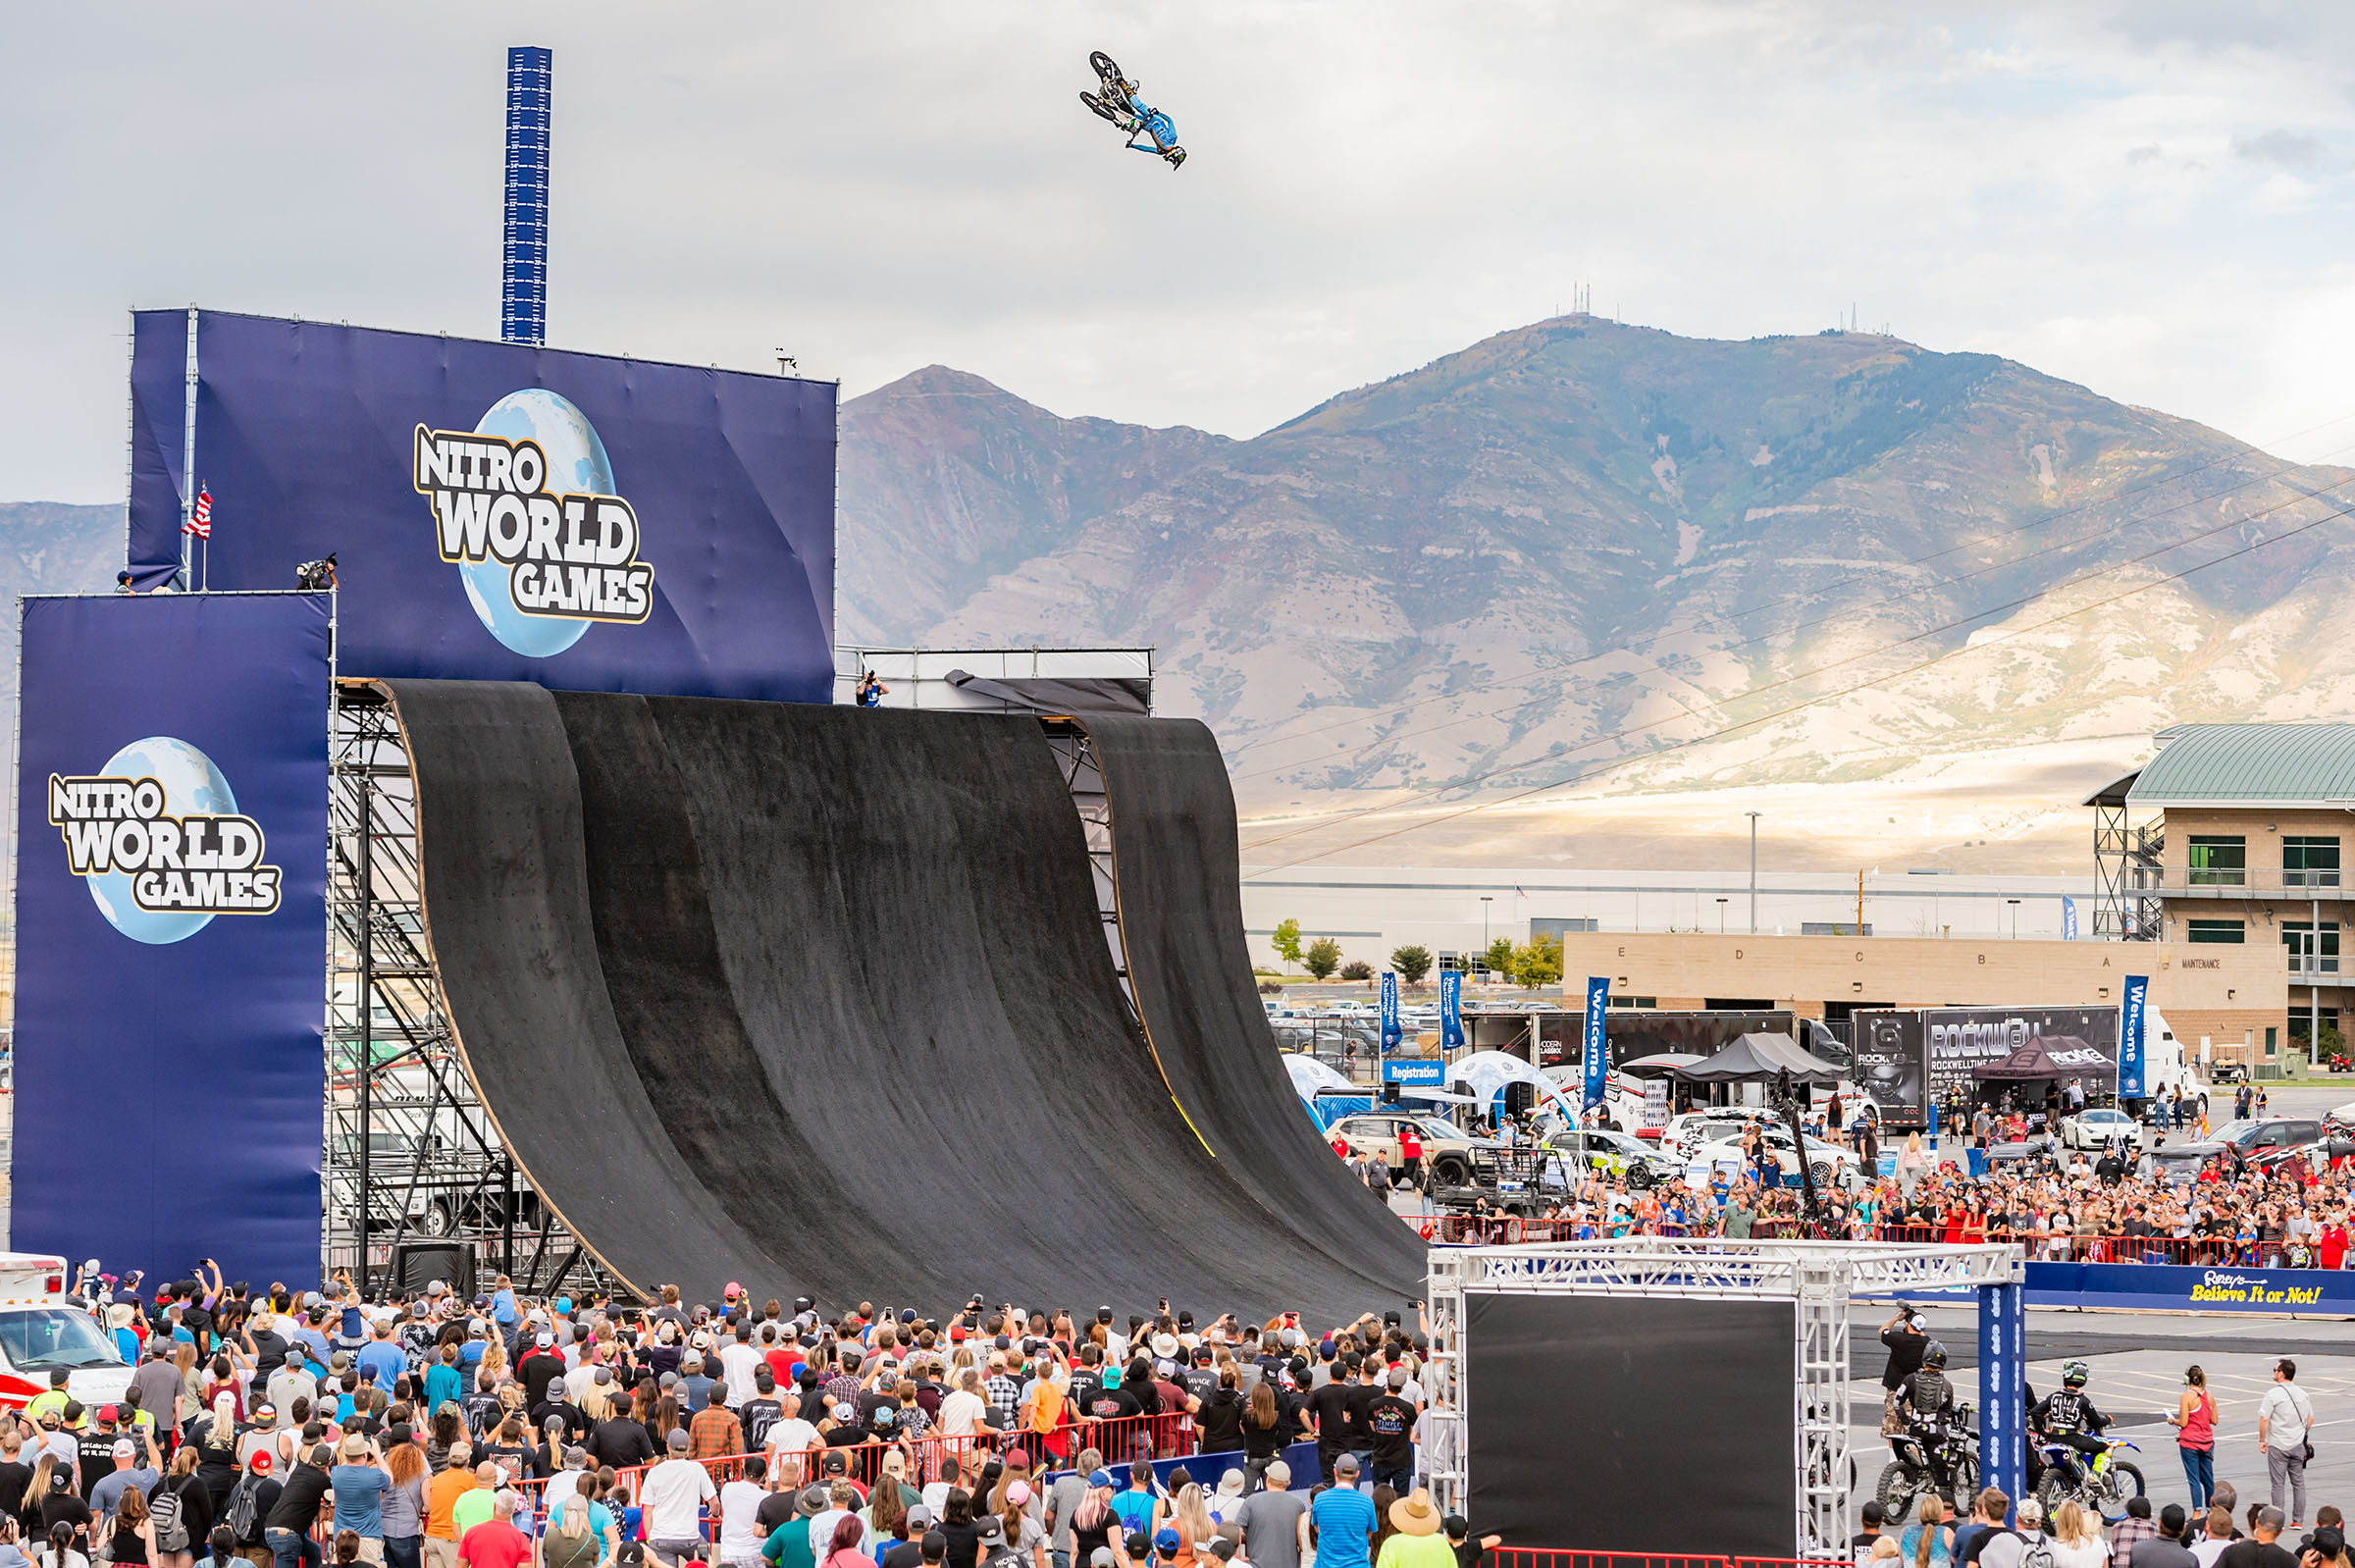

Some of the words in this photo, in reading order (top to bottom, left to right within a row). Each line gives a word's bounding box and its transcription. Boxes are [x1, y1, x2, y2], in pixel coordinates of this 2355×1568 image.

[420, 433, 544, 494] NITRO
[437, 491, 635, 566] WORLD
[513, 562, 650, 615] GAMES
[53, 780, 162, 819] NITRO
[67, 819, 259, 869] WORLD
[135, 871, 276, 909] GAMES
[1618, 947, 1625, 957] E
[1736, 949, 1744, 960] D
[1856, 951, 1863, 962] C
[1977, 954, 1986, 965] B
[2103, 957, 2111, 967] A
[2181, 958, 2221, 969] MAINTENANCE
[1589, 988, 1603, 1077] Welcome
[2125, 985, 2144, 1063] Welcome
[1932, 1058, 1999, 1070] ROCKWELLTIME
[1391, 1066, 1439, 1084] Registration
[2204, 1270, 2259, 1288] Ripley's
[2189, 1284, 2247, 1302] Believe
[2248, 1285, 2265, 1303] It
[2266, 1290, 2285, 1303] or
[2284, 1285, 2323, 1305] Not!
[1186, 1377, 1212, 1386] SAVAGE
